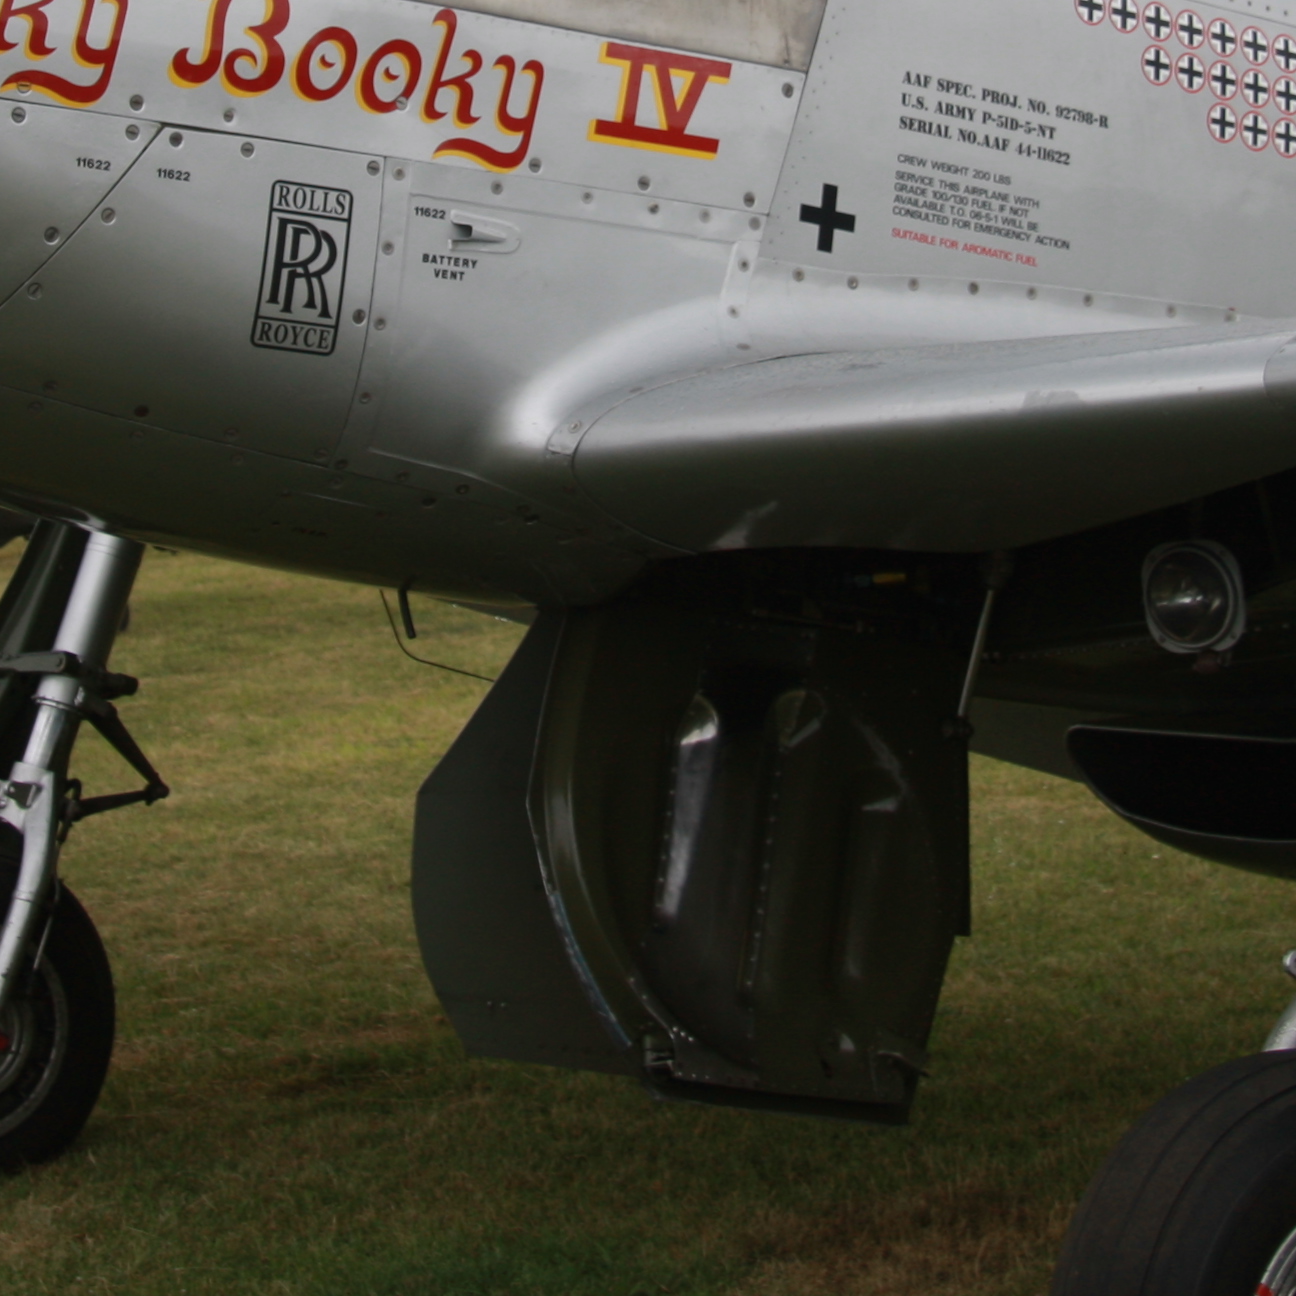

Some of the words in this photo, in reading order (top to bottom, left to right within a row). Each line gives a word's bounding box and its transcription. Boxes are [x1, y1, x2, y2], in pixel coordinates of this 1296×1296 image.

[586, 40, 733, 160] IV
[901, 93, 928, 111] U.S.
[934, 101, 977, 122] ARMY
[982, 112, 1056, 140] P-51D-5-NT
[902, 71, 931, 88] AAF
[937, 78, 976, 98] SPEC.
[981, 88, 1022, 109] PROJ.
[1027, 98, 1050, 116] NO.
[1056, 105, 1109, 128] 92798-R
[899, 116, 952, 140] SERIAL
[1015, 142, 1071, 165] 44-11622
[76, 157, 111, 171] 11622
[157, 168, 191, 182] 11622
[897, 154, 926, 168] CREW
[931, 161, 969, 176] WEIGHT
[972, 170, 990, 181] 200
[994, 174, 1011, 185] LBS
[277, 185, 346, 215] ROLLS
[894, 183, 928, 197] GRADE
[932, 191, 968, 206] 100/130
[999, 202, 1006, 213] IF
[1009, 205, 1029, 218] NOT
[895, 171, 934, 187] SERVICE
[938, 180, 960, 193] THIS
[963, 185, 1009, 202] AIRPLANE
[1014, 196, 1040, 209] WITH
[414, 206, 446, 219] 11622
[893, 206, 949, 225] CONSULTED
[952, 218, 971, 230] FOR
[974, 223, 1032, 242] EMERGENCY
[1035, 236, 1070, 250] ACTION
[894, 195, 945, 213] AVAILABLE
[1001, 217, 1024, 229] WILL
[1027, 222, 1039, 233] BE
[422, 254, 478, 269] BATTERY
[892, 227, 936, 246] SUITABLE
[939, 238, 958, 249] FOR
[962, 243, 1013, 262] AROMATIC
[1016, 254, 1038, 267] FUEL
[434, 269, 465, 281] VENT
[257, 322, 331, 349] ROYCE
